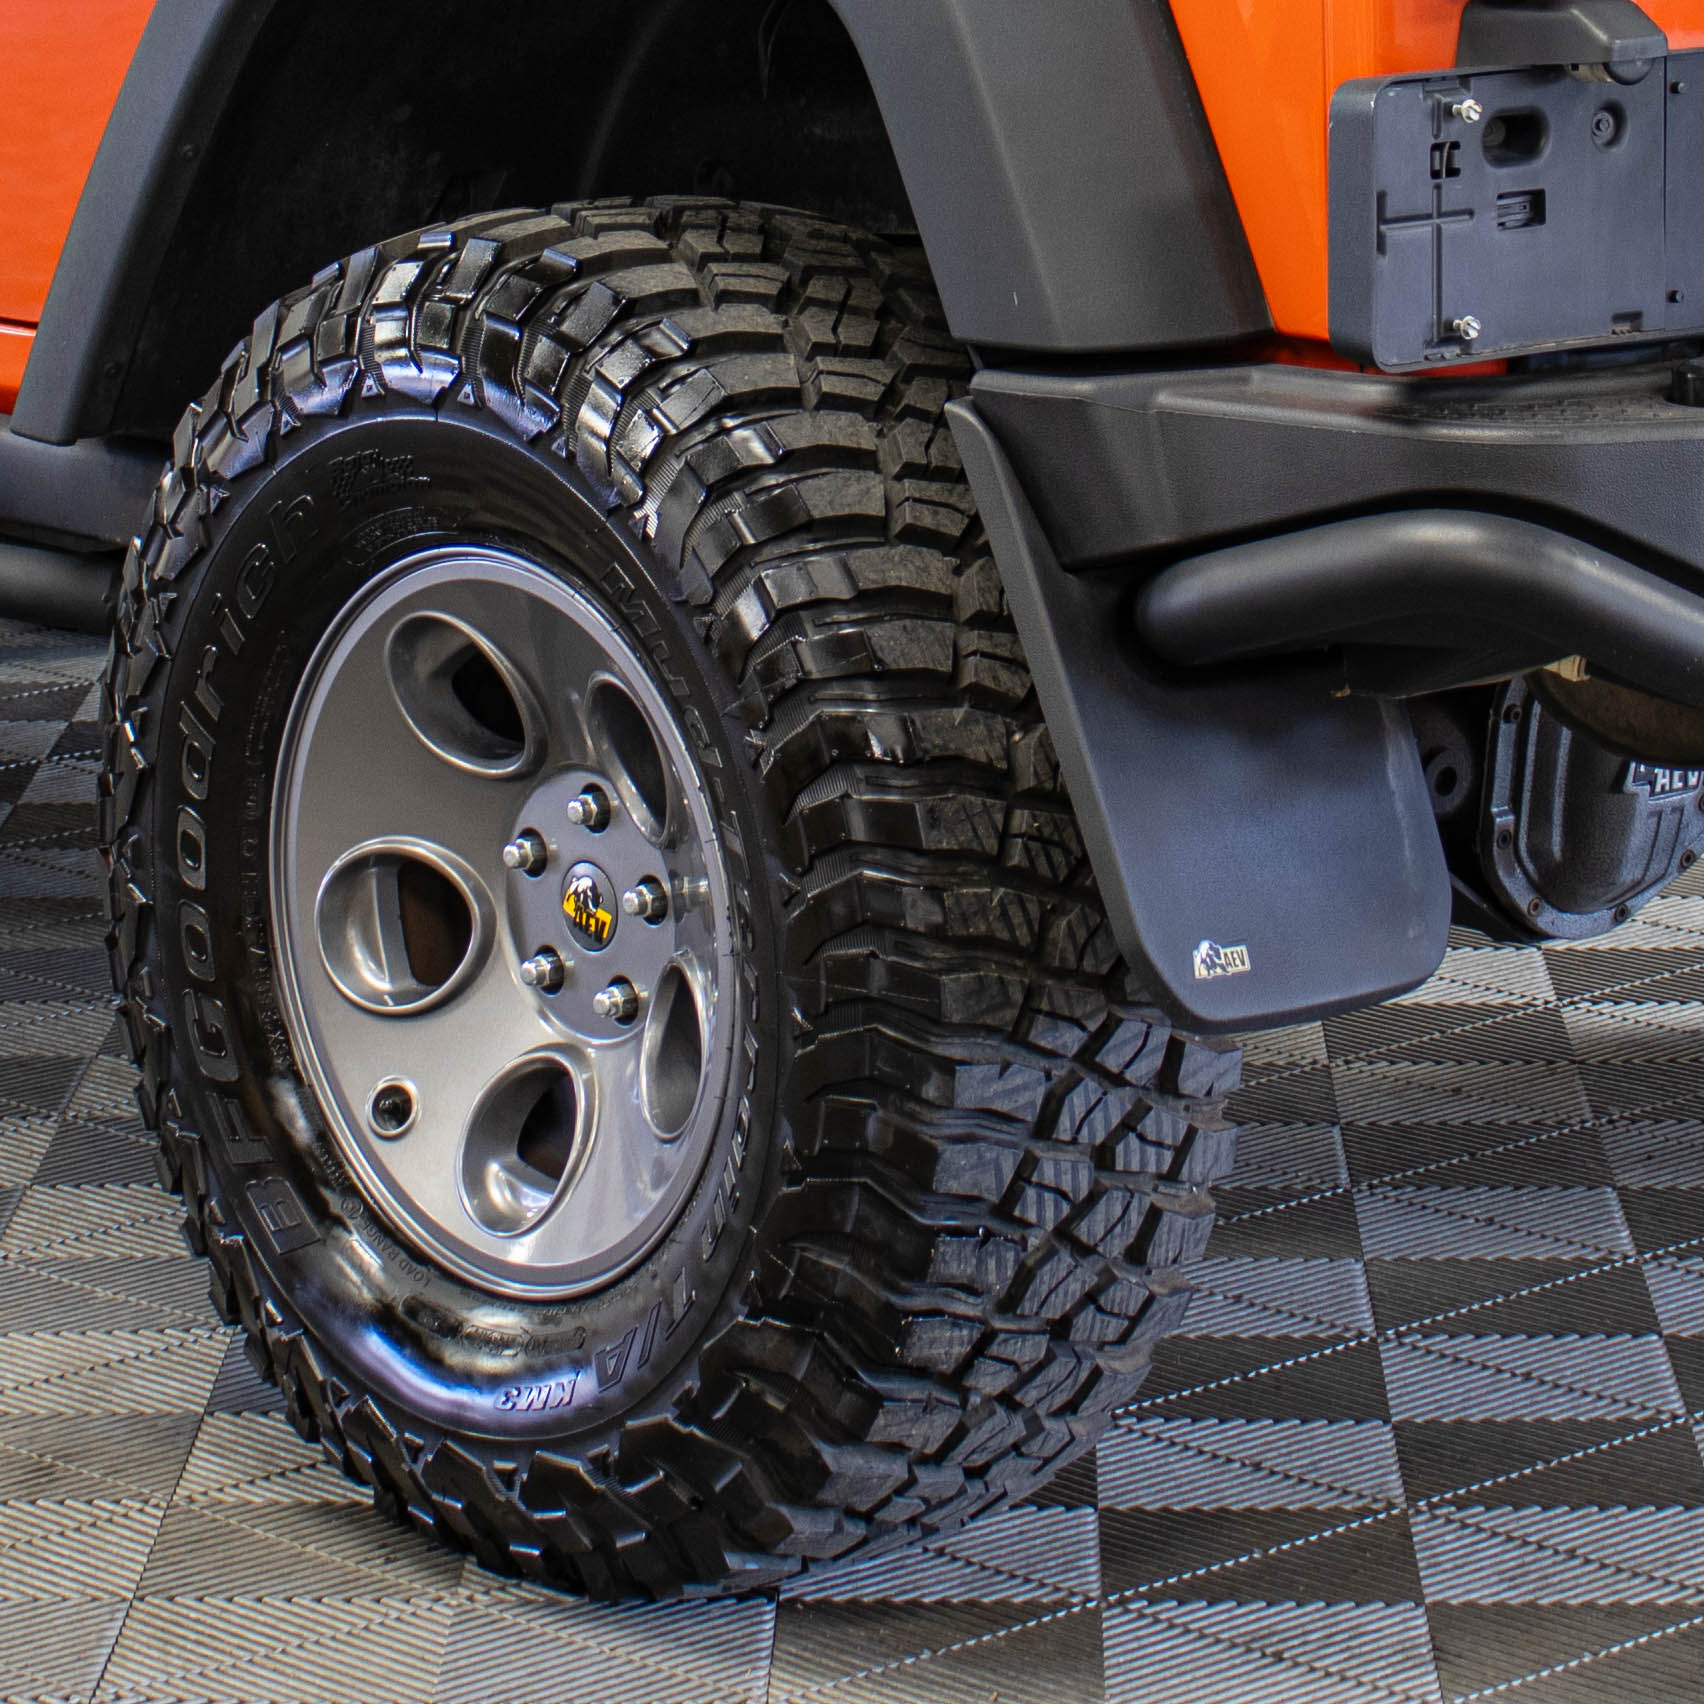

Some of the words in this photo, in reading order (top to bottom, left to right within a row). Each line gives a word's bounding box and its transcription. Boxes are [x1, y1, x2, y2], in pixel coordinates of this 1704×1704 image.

[176, 494, 319, 1256] BFGoodrich
[1223, 948, 1246, 969] AEV
[495, 1370, 582, 1413] KM3
